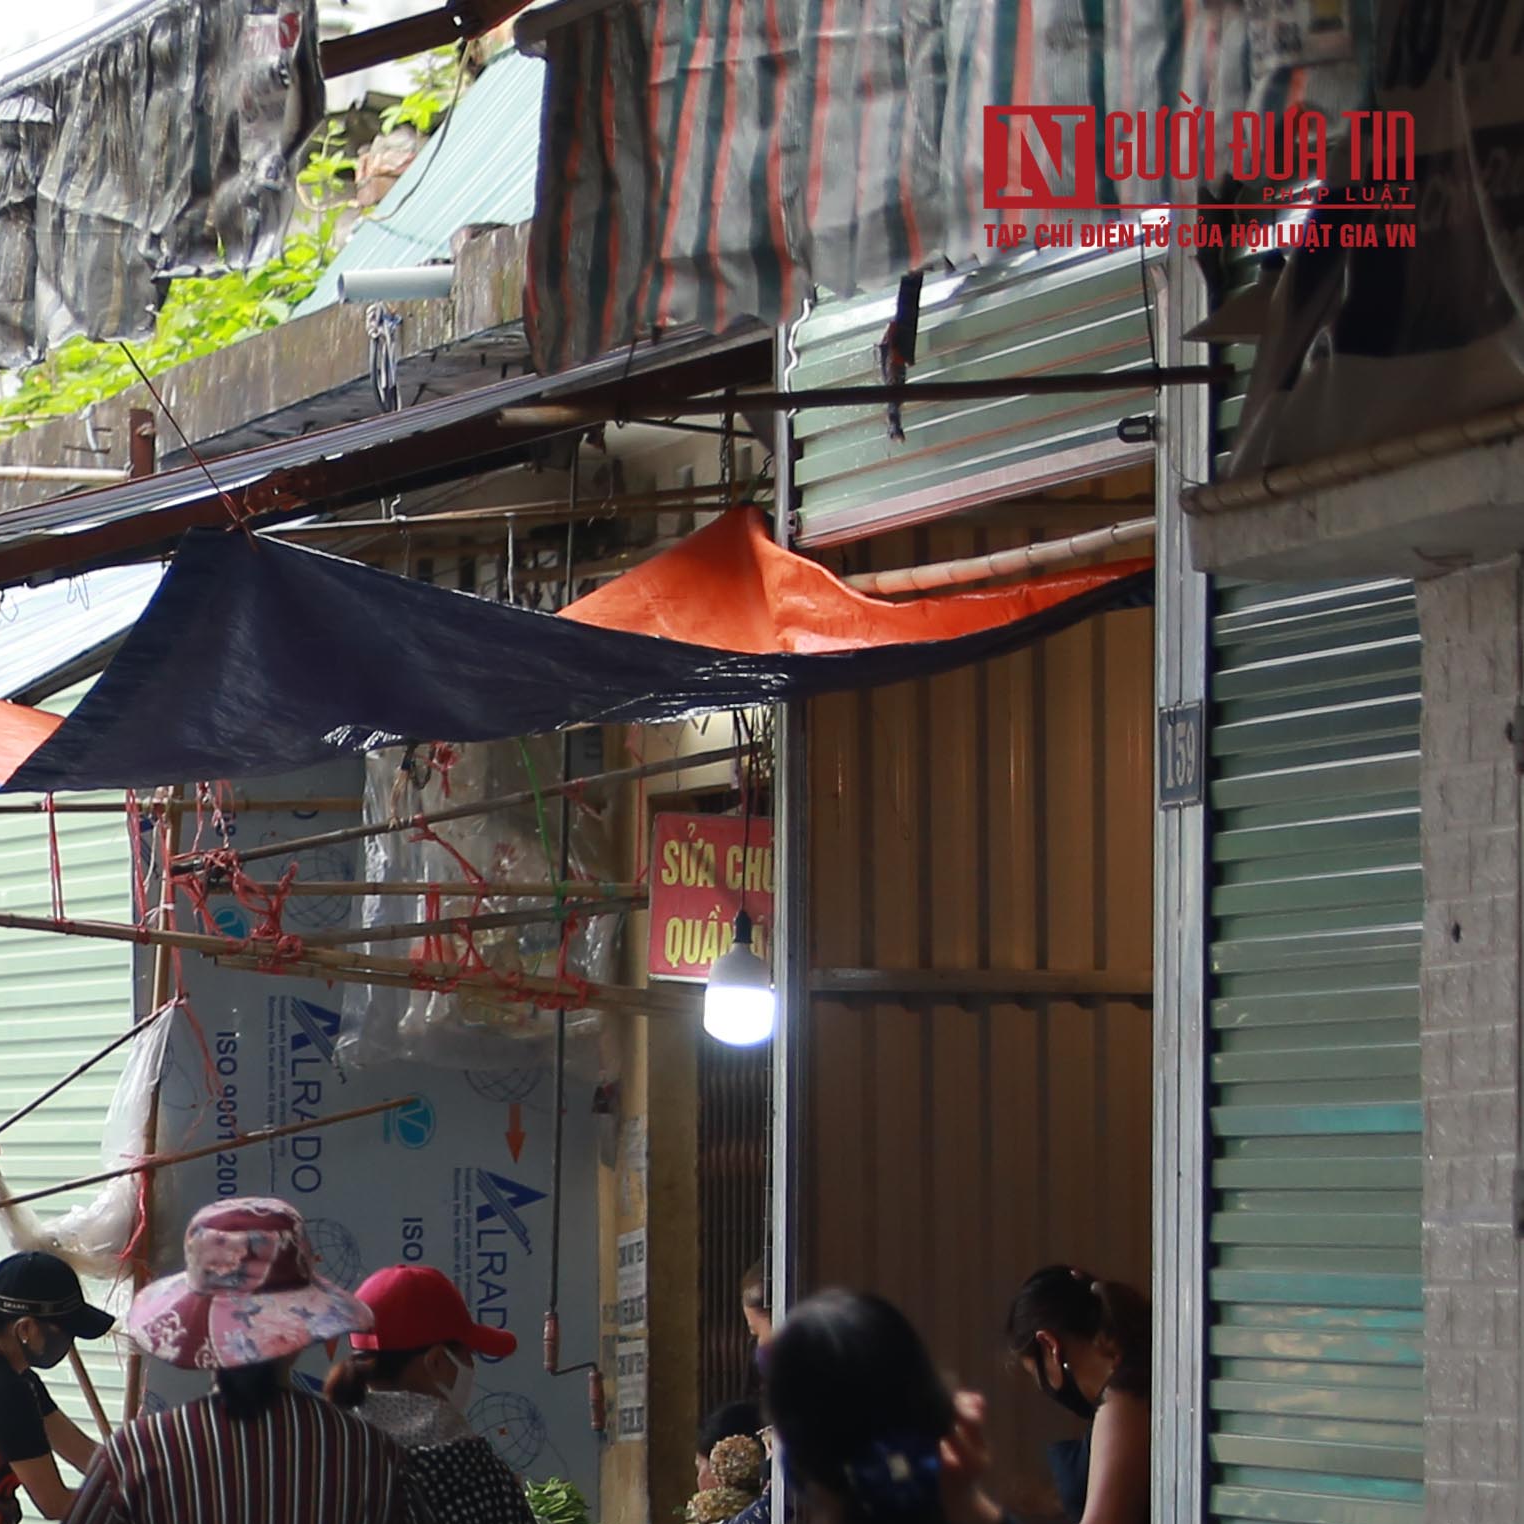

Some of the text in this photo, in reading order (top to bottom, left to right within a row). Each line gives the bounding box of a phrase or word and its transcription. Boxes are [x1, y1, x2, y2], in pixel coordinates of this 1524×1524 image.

[1165, 720, 1196, 789] 159
[661, 822, 717, 889] SỬA
[216, 1031, 238, 1077] ISO
[402, 1217, 424, 1262] ISO
